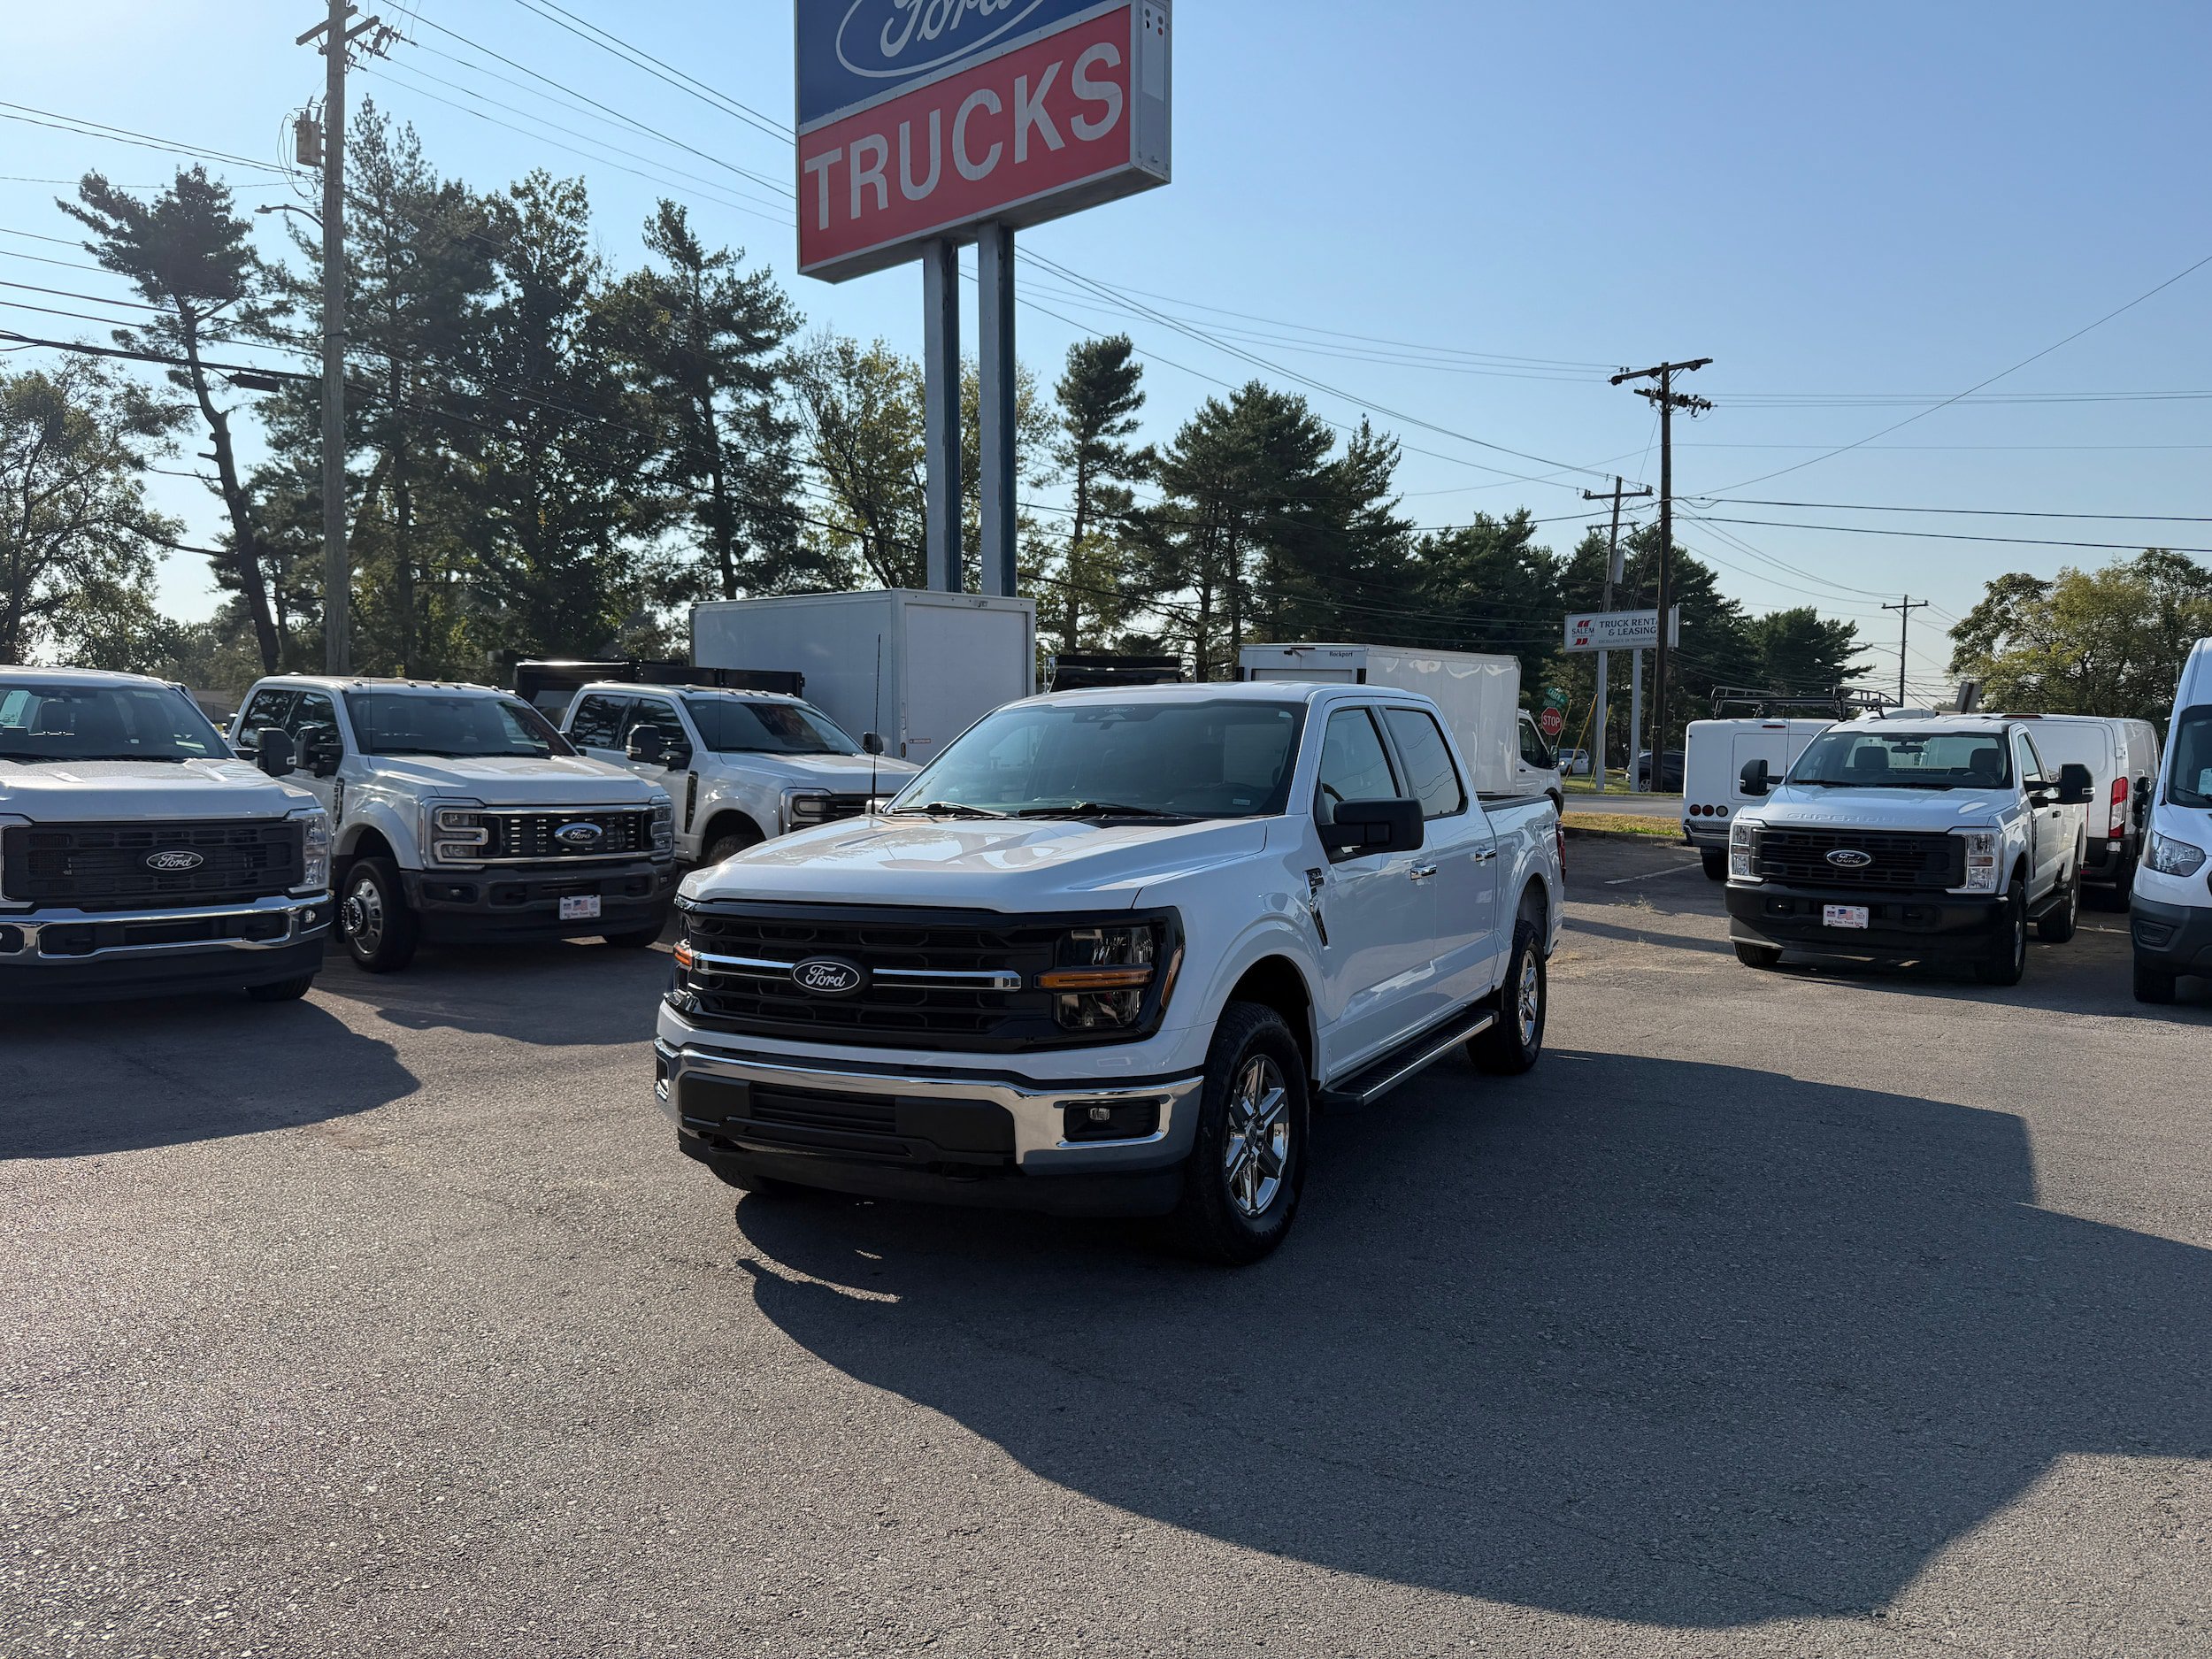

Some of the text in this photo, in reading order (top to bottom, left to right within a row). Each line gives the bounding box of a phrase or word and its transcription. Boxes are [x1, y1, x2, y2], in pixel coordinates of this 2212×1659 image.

[803, 42, 1124, 232] TRUCKS
[1599, 618, 1658, 628] TRUCK RENT
[1617, 626, 1657, 636] LEASING
[1542, 715, 1561, 727] STOP
[570, 829, 592, 840] Ford
[157, 853, 193, 867] Ford
[1836, 852, 1862, 864] Ford
[805, 964, 847, 987] Ford
